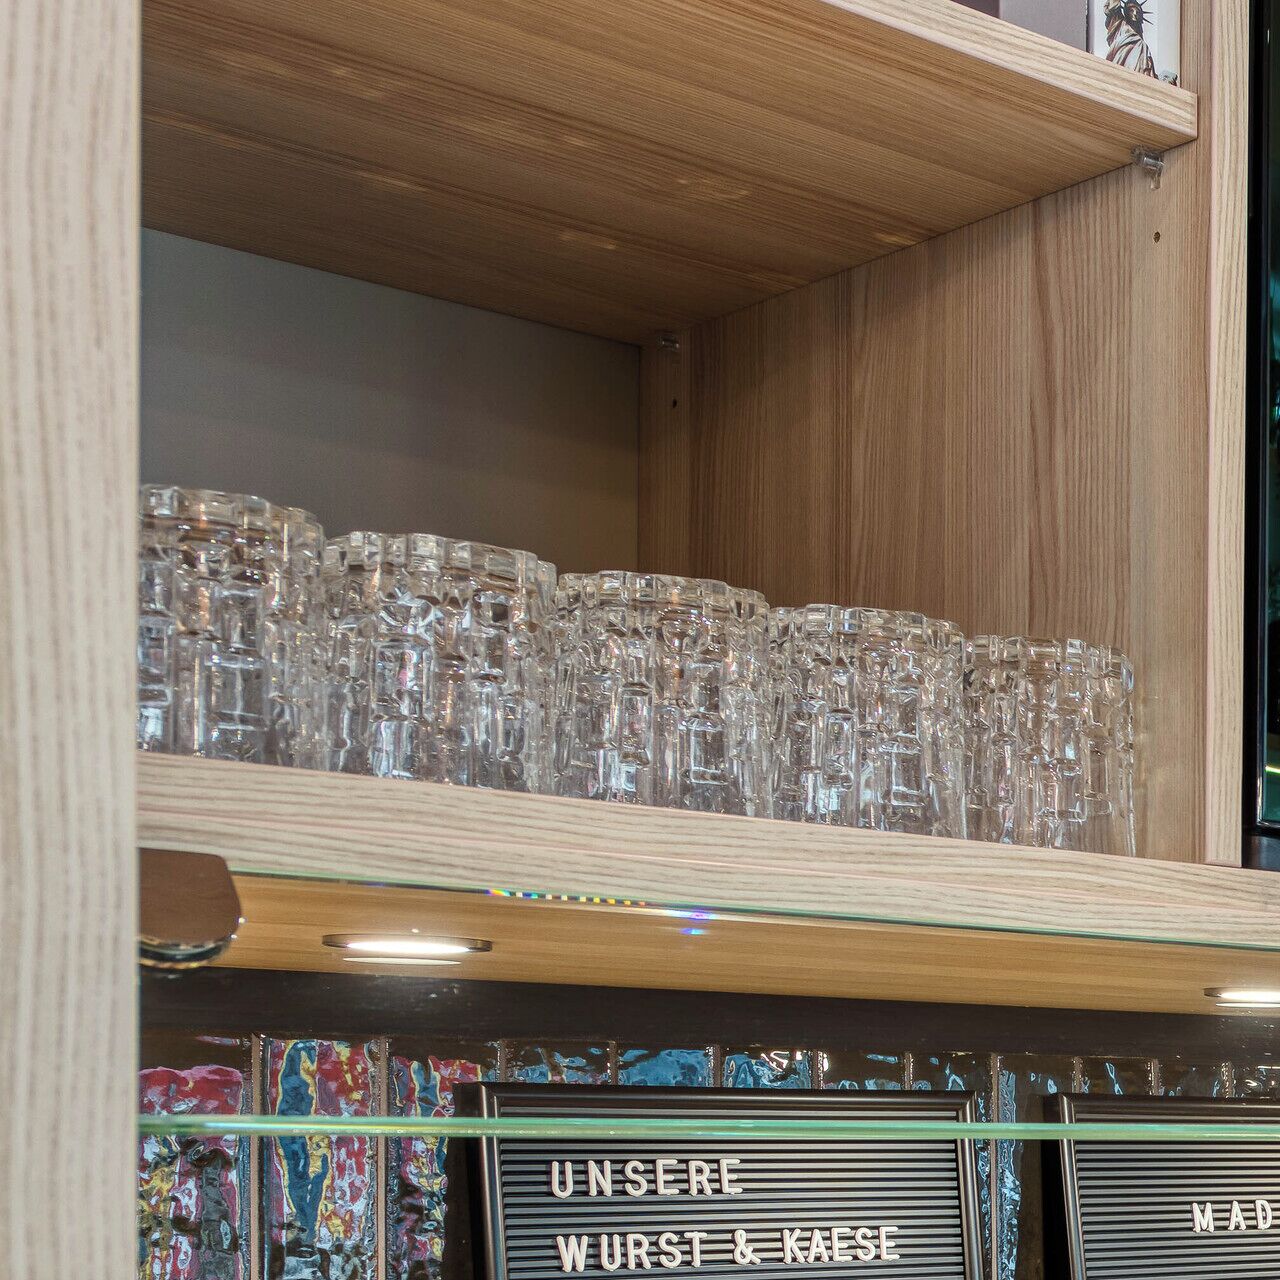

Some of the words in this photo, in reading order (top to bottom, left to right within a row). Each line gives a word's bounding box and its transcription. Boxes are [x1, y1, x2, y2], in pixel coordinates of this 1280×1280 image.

[550, 1158, 745, 1199] UNSERE
[556, 1231, 708, 1273] WURST
[732, 1228, 762, 1266] &
[781, 1225, 901, 1266] KAESE
